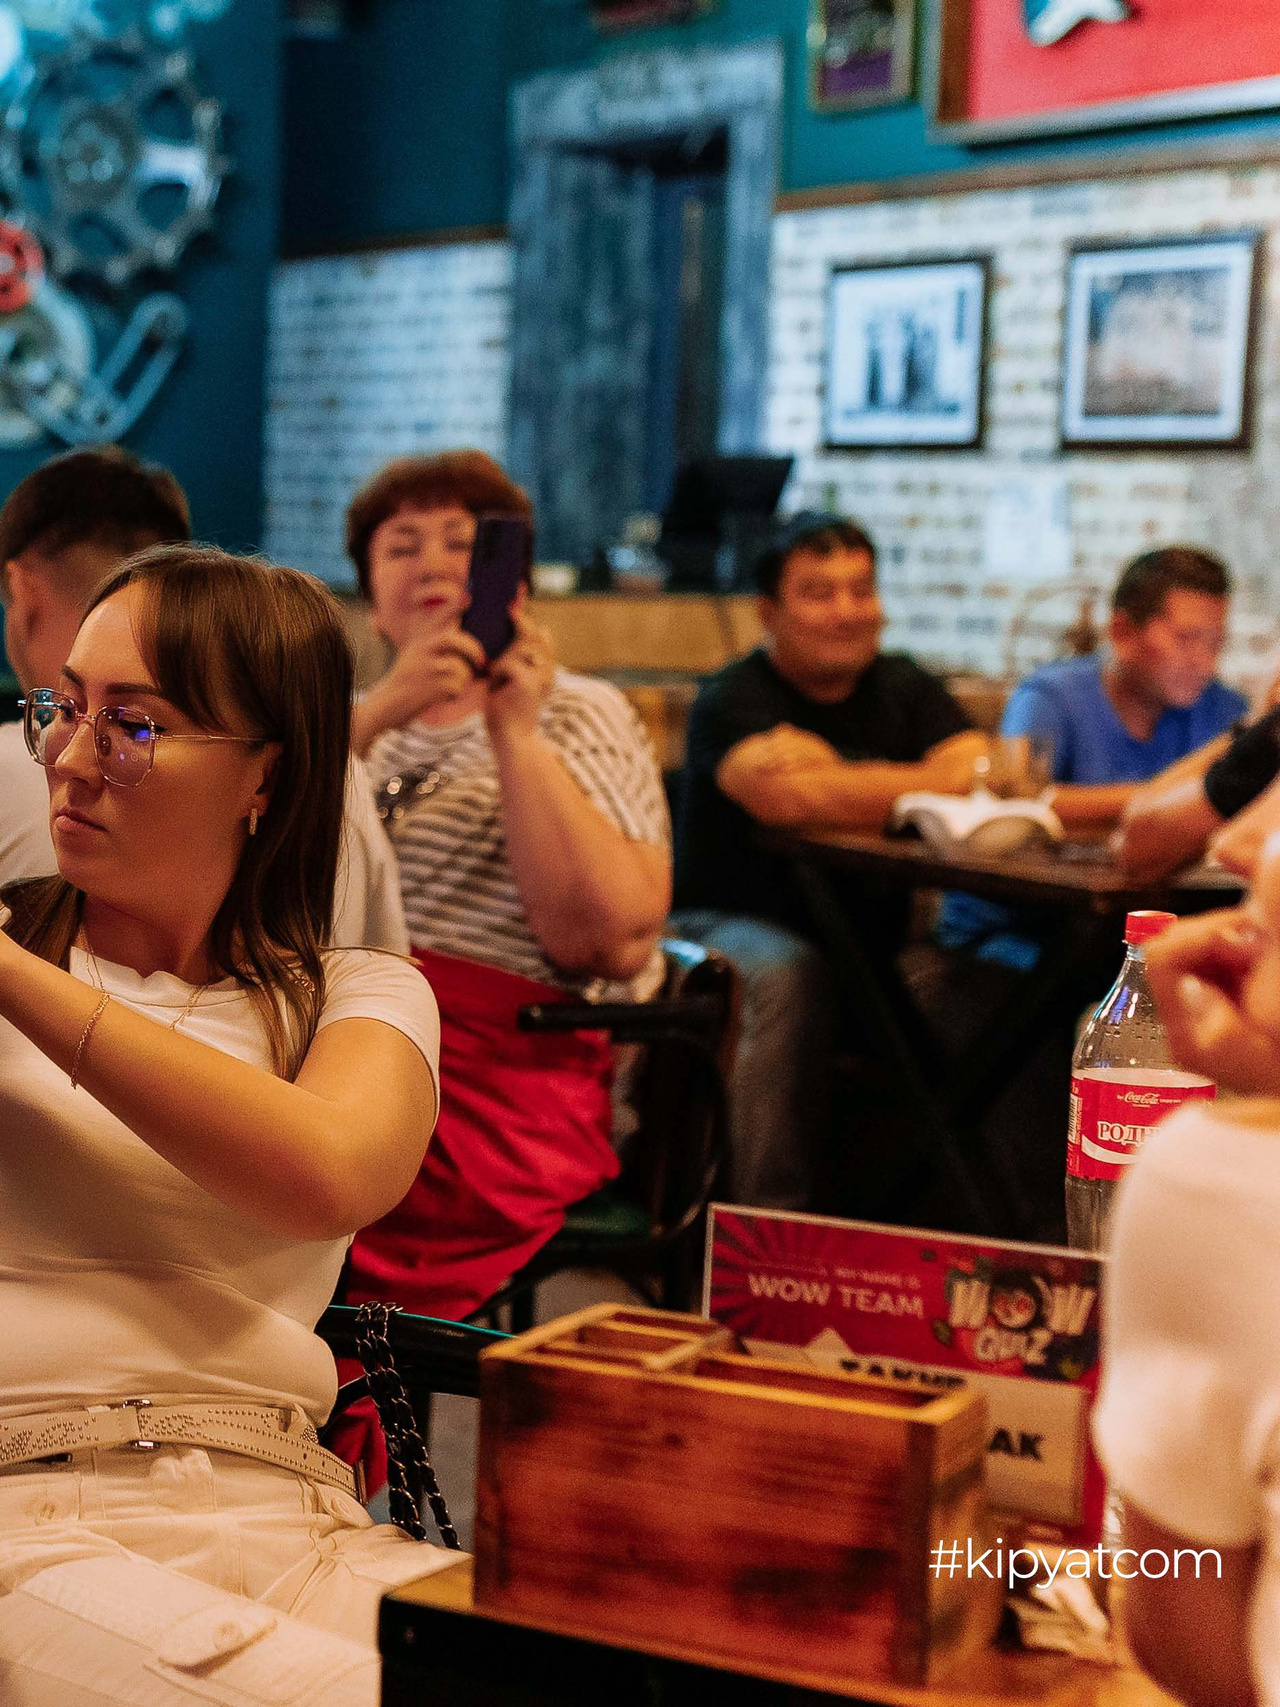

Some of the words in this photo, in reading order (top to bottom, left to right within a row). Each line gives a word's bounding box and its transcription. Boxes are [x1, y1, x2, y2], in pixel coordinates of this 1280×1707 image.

[748, 1272, 831, 1307] WOW
[837, 1284, 924, 1320] TEAM
[949, 1274, 1097, 1336] WOW
